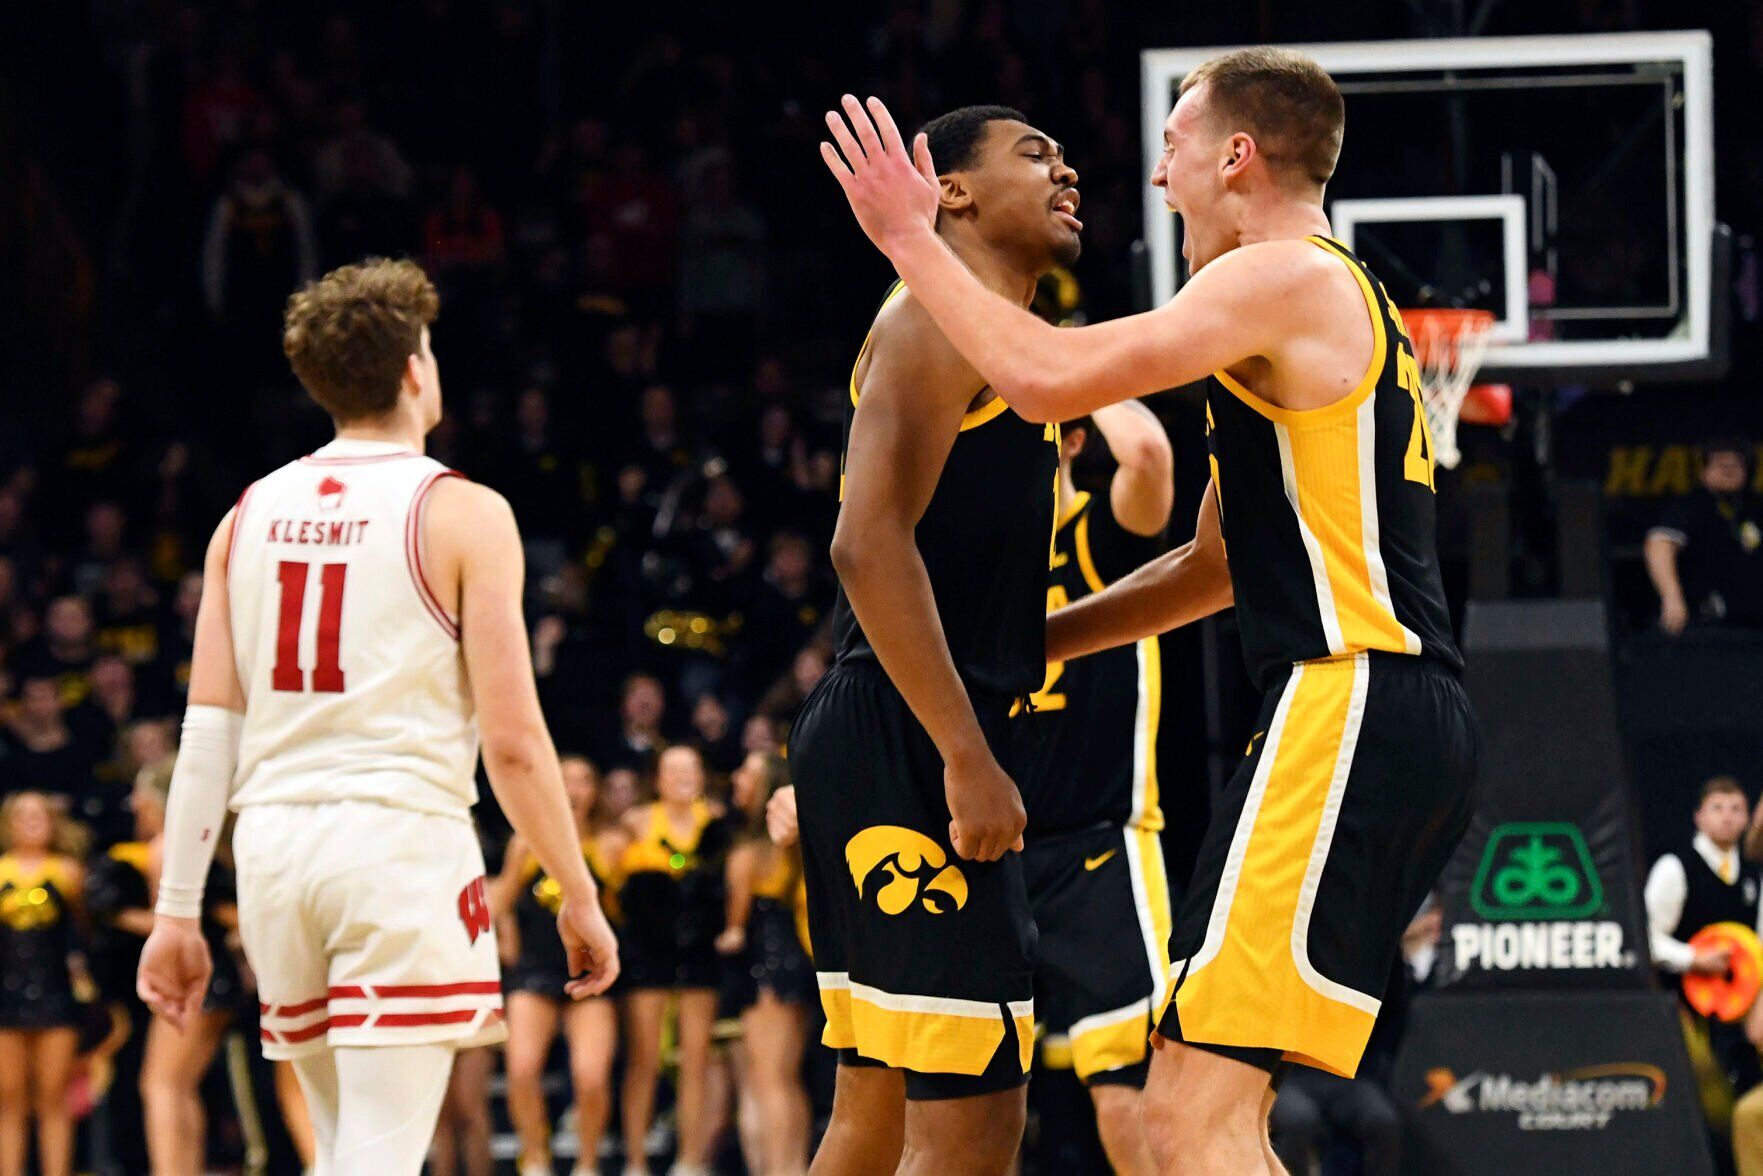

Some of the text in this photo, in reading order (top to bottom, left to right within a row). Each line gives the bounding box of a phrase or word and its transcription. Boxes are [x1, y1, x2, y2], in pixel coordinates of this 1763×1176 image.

[267, 518, 370, 546] KLESMIT
[271, 560, 347, 693] 11
[1452, 922, 1624, 970] PIONEER
[1478, 1072, 1651, 1112] Mediacom
